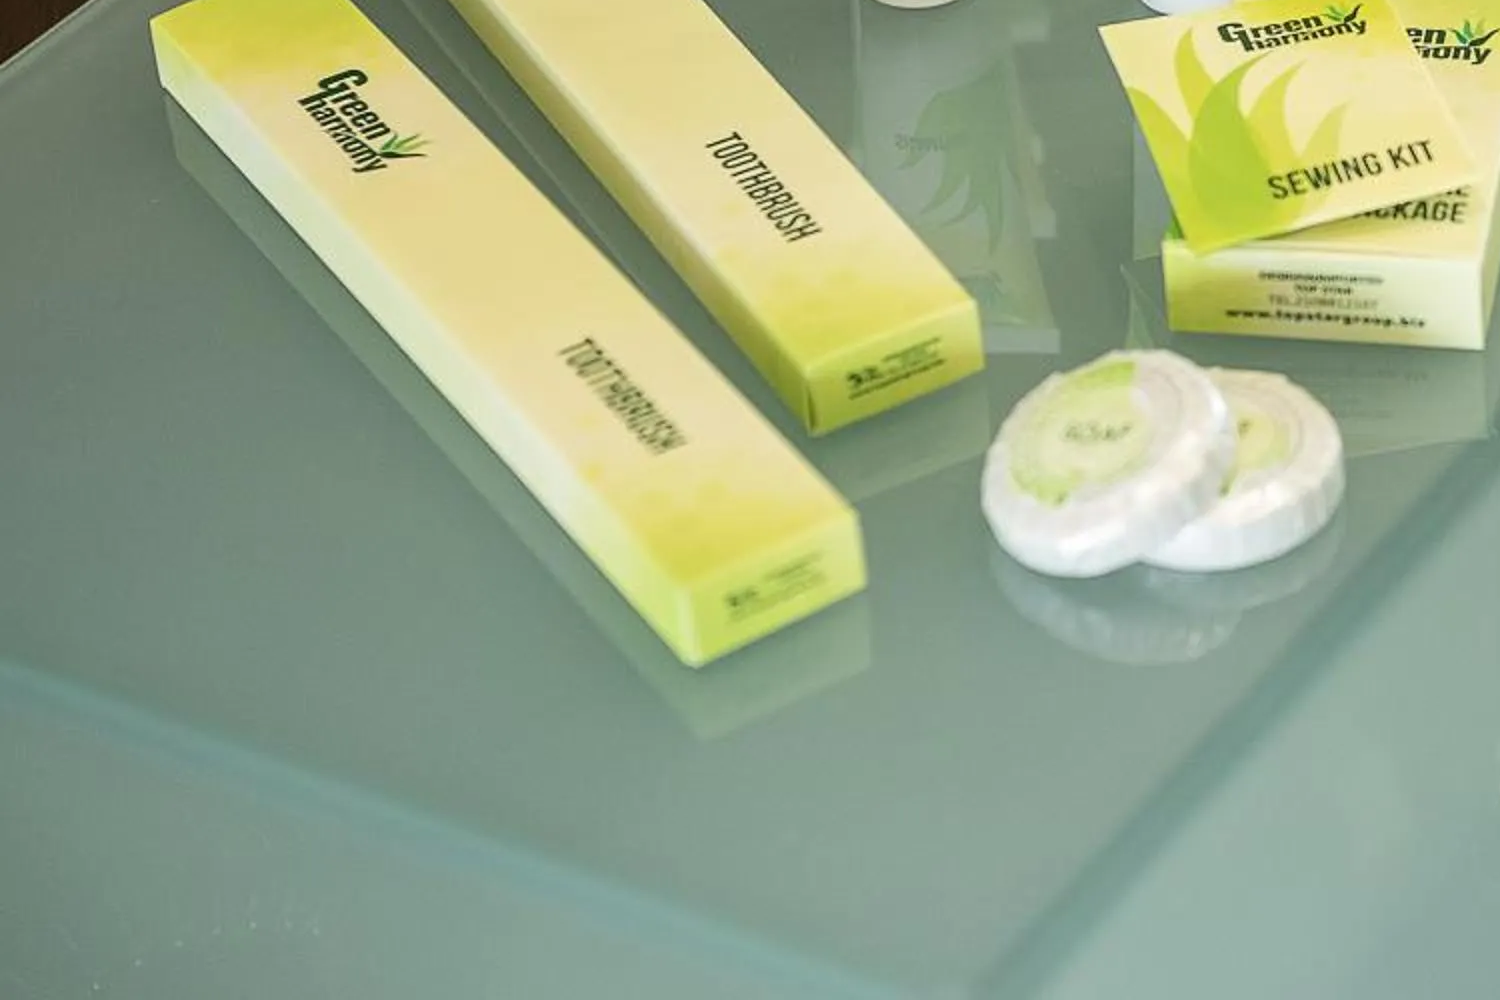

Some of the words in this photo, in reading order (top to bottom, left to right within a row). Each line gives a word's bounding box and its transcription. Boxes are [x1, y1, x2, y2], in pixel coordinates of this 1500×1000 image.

[1217, 15, 1324, 43] Green
[1242, 19, 1367, 52] harmony
[297, 91, 388, 173] harmony
[318, 69, 391, 140] Green
[705, 131, 823, 243] TOOTHBRUSH
[1267, 152, 1384, 200] SEWING
[1386, 139, 1435, 169] KIT
[556, 337, 689, 457] TOOTHBRUSH
